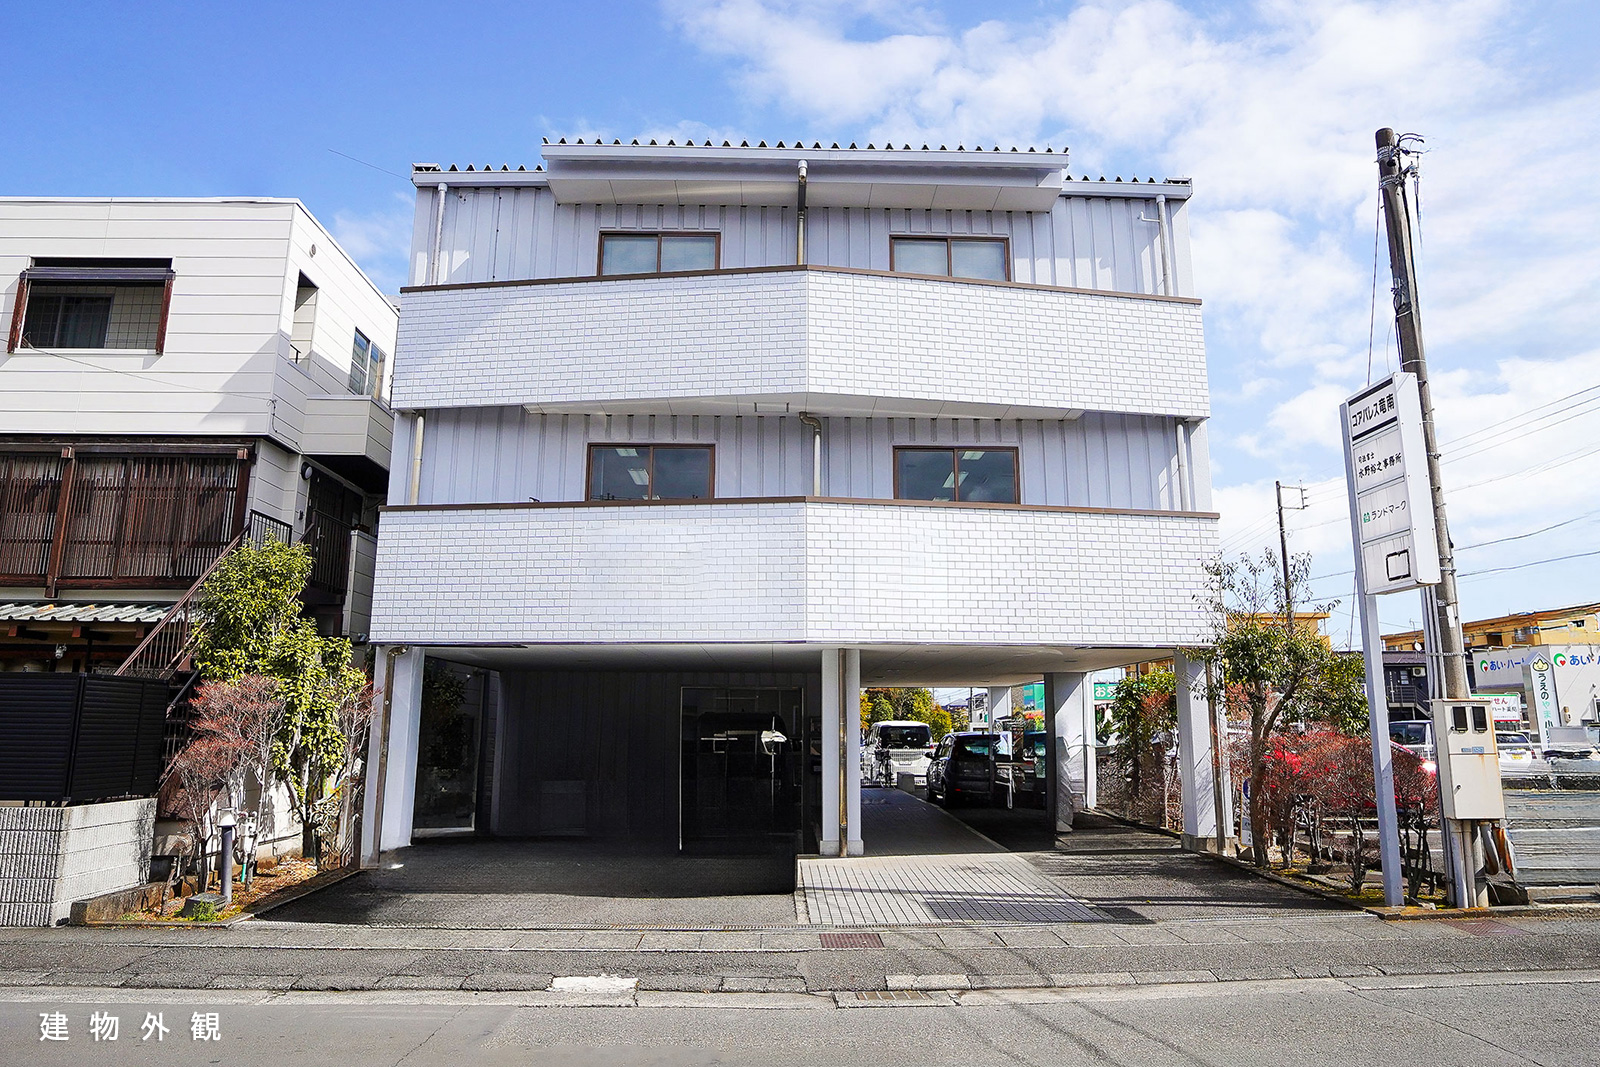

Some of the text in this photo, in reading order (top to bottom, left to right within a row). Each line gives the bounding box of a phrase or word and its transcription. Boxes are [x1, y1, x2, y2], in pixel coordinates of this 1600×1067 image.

[1371, 500, 1407, 520] ランドマーク
